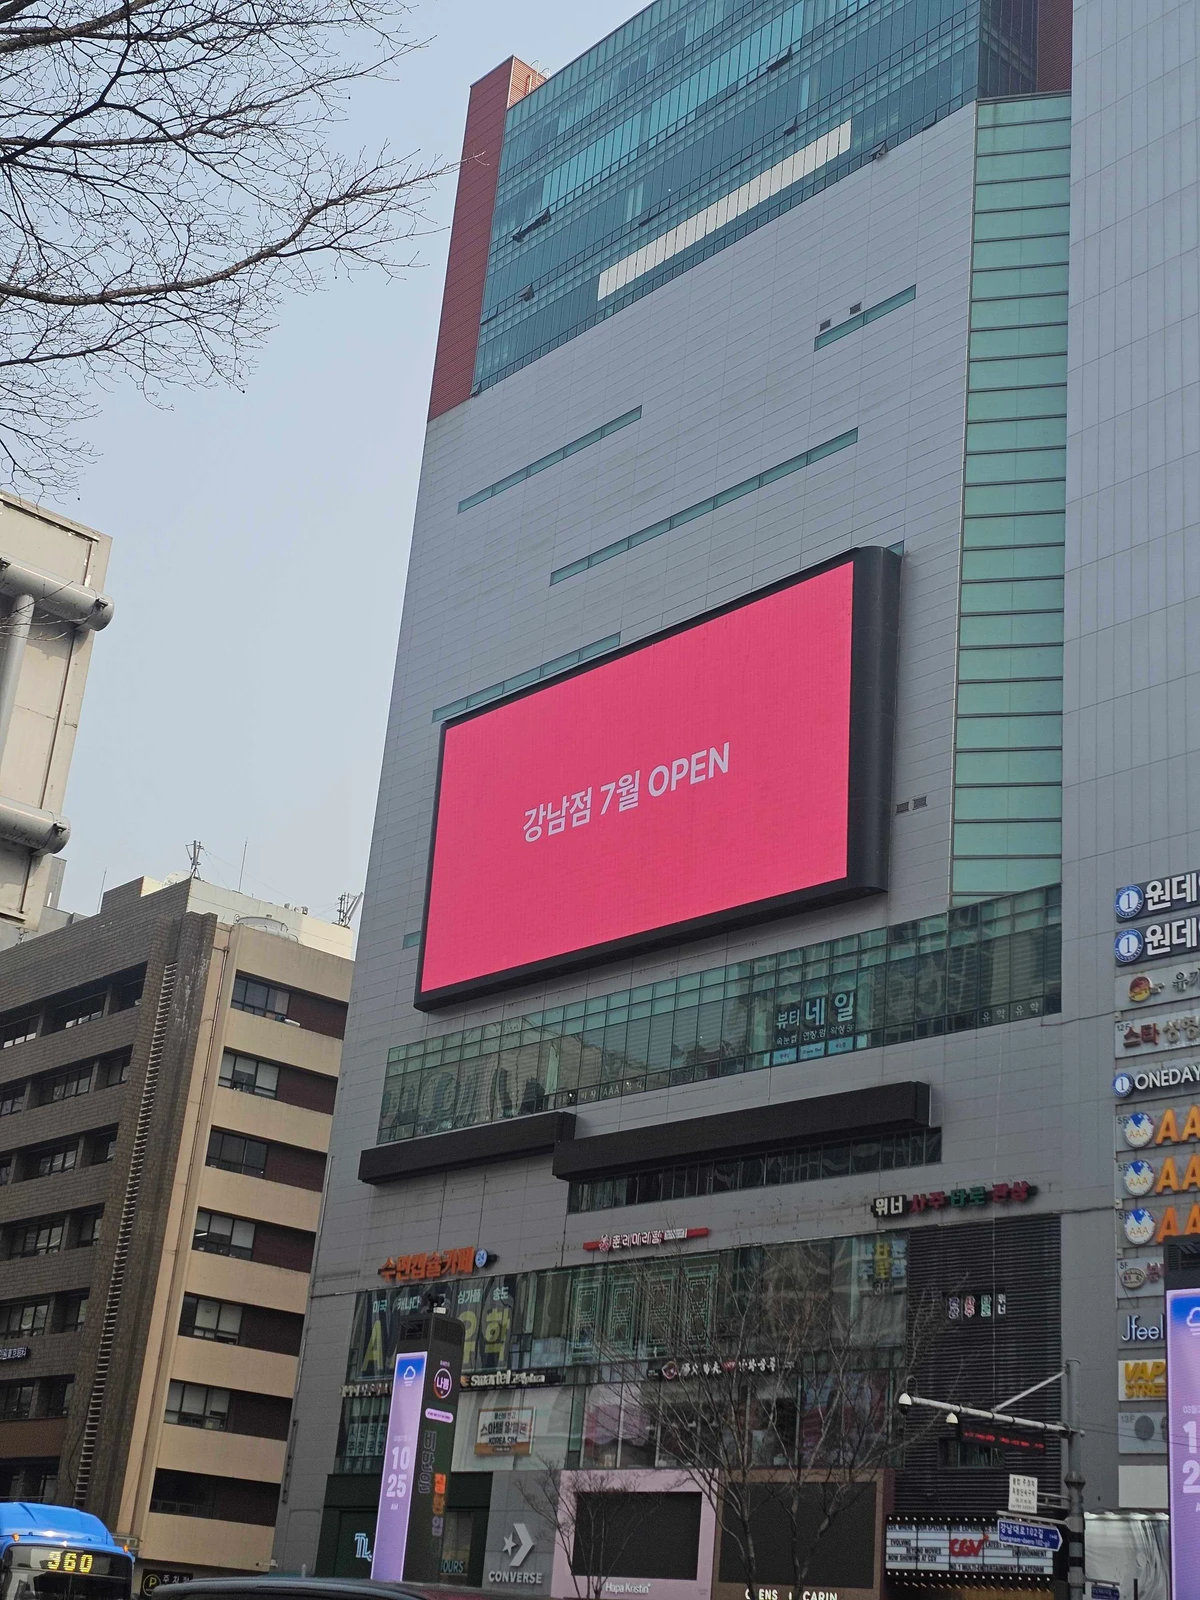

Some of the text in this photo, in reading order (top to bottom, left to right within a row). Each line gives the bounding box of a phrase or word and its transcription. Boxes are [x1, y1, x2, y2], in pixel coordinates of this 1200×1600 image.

[523, 742, 730, 842] 강남점 7월 OPEN
[1145, 872, 1200, 911] 원데
[1145, 917, 1200, 956] 원데
[776, 992, 854, 1029] 뷰티 네일
[1123, 1023, 1160, 1048] 스타
[602, 1085, 620, 1096] AAA
[1129, 1128, 1148, 1138] AAA
[1129, 1177, 1148, 1187] AAA
[875, 1195, 903, 1216] 위너
[910, 1191, 946, 1214] 사주
[950, 1186, 986, 1208] 타로
[1129, 1226, 1149, 1236] AAA
[381, 1246, 474, 1282] 수면캡슐카페
[457, 1288, 482, 1304] 싱가폴
[492, 1286, 508, 1301] 송도
[372, 1299, 387, 1314] 미국
[397, 1295, 421, 1311] 캐나다
[471, 1370, 511, 1386] smartel
[481, 1421, 503, 1437] 스마텔
[489, 1436, 517, 1444] KOREA SIM
[392, 1446, 410, 1470] 10
[386, 1473, 407, 1498] 25
[1000, 1522, 1043, 1539] 강남대로102길
[891, 1539, 911, 1547] EVOLVING
[949, 1536, 986, 1557] CGV
[488, 1571, 543, 1584] CONVERSE
[605, 1582, 649, 1594] Hapa Kristin
[745, 1588, 838, 1600] ENS CARIN
